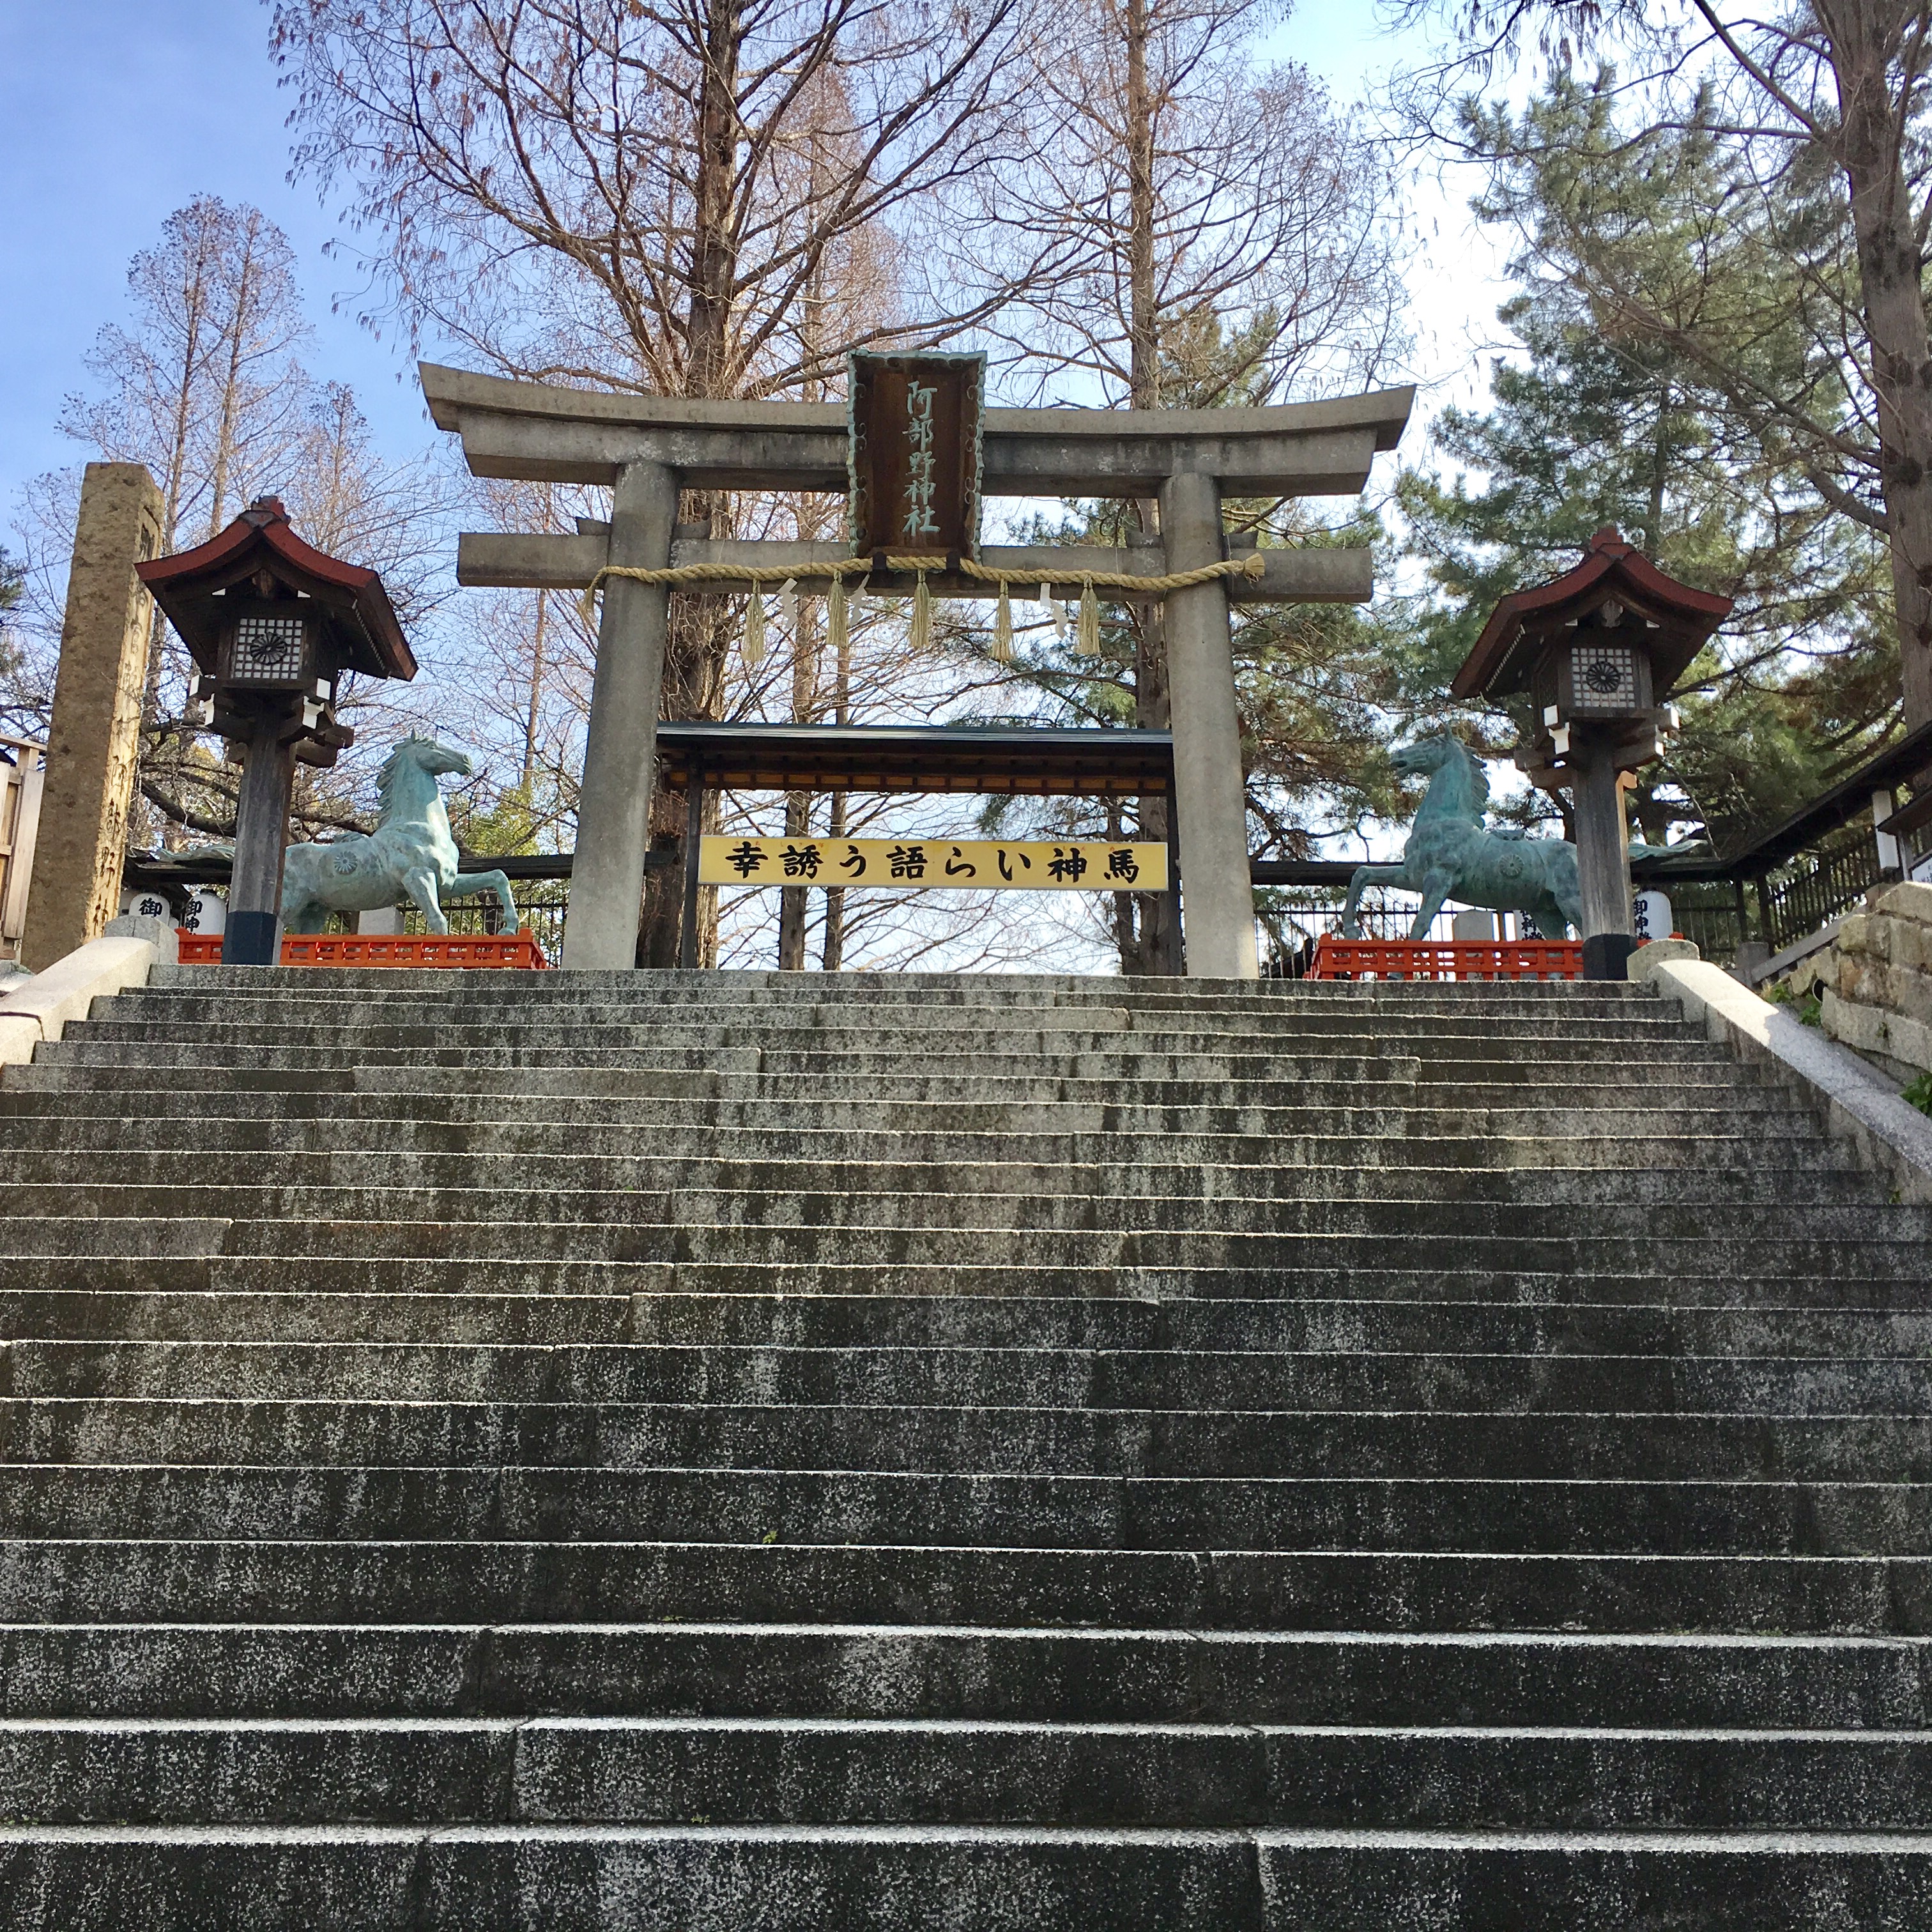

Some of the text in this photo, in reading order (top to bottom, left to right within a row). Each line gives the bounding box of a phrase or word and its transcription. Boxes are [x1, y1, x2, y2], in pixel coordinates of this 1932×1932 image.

[902, 380, 940, 537] 阿部野神社
[725, 841, 1140, 884] 幸誘う語らい神馬
[139, 897, 162, 917] 御
[185, 898, 203, 934] 御神
